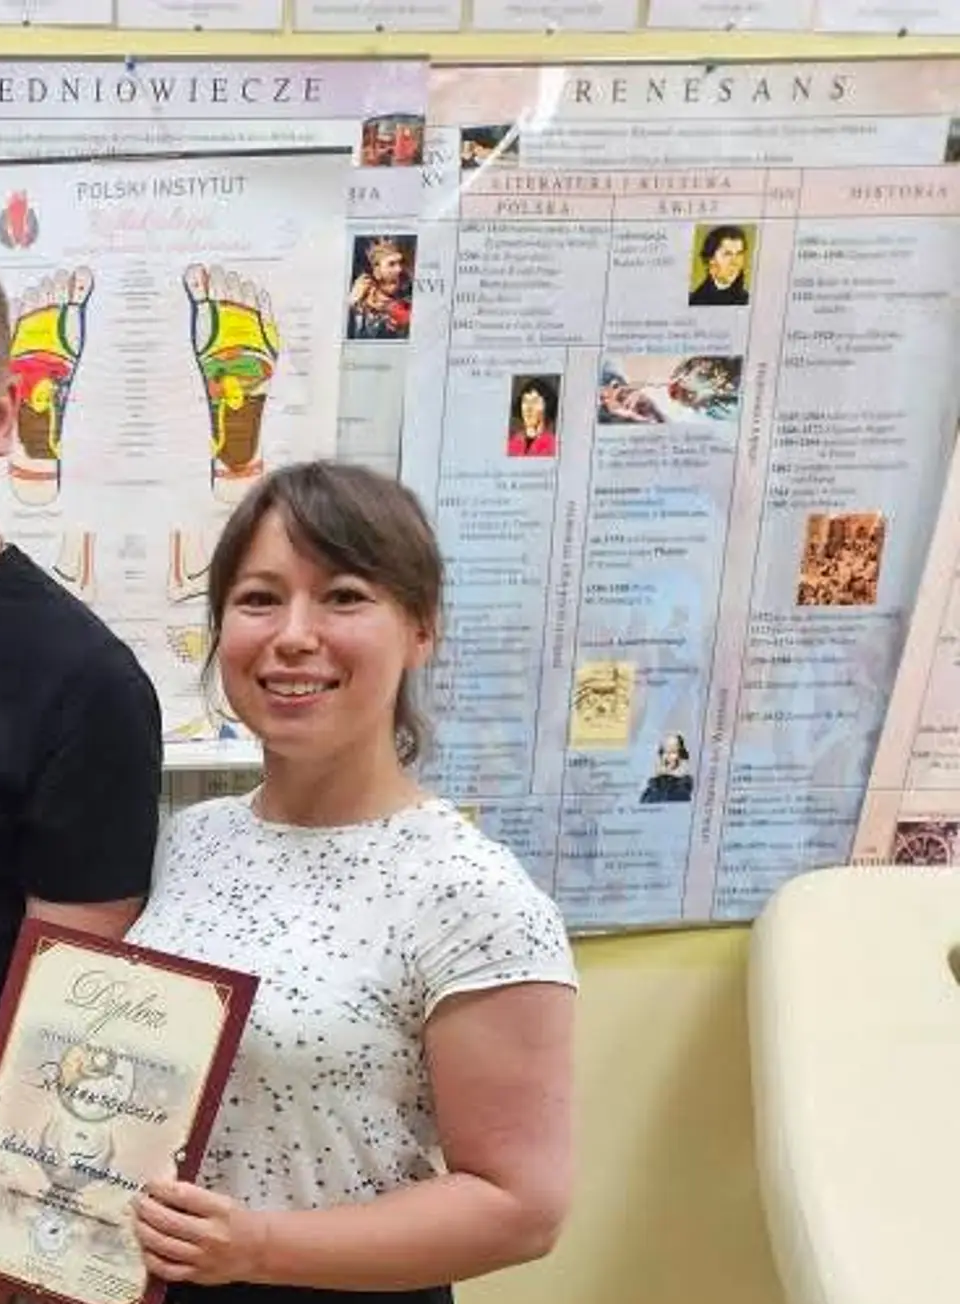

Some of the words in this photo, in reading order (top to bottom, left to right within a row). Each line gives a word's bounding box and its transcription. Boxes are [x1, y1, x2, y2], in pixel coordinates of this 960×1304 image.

[574, 76, 848, 103] RENESANS
[76, 180, 146, 201] POLSKI
[152, 176, 248, 200] INSTYTUT
